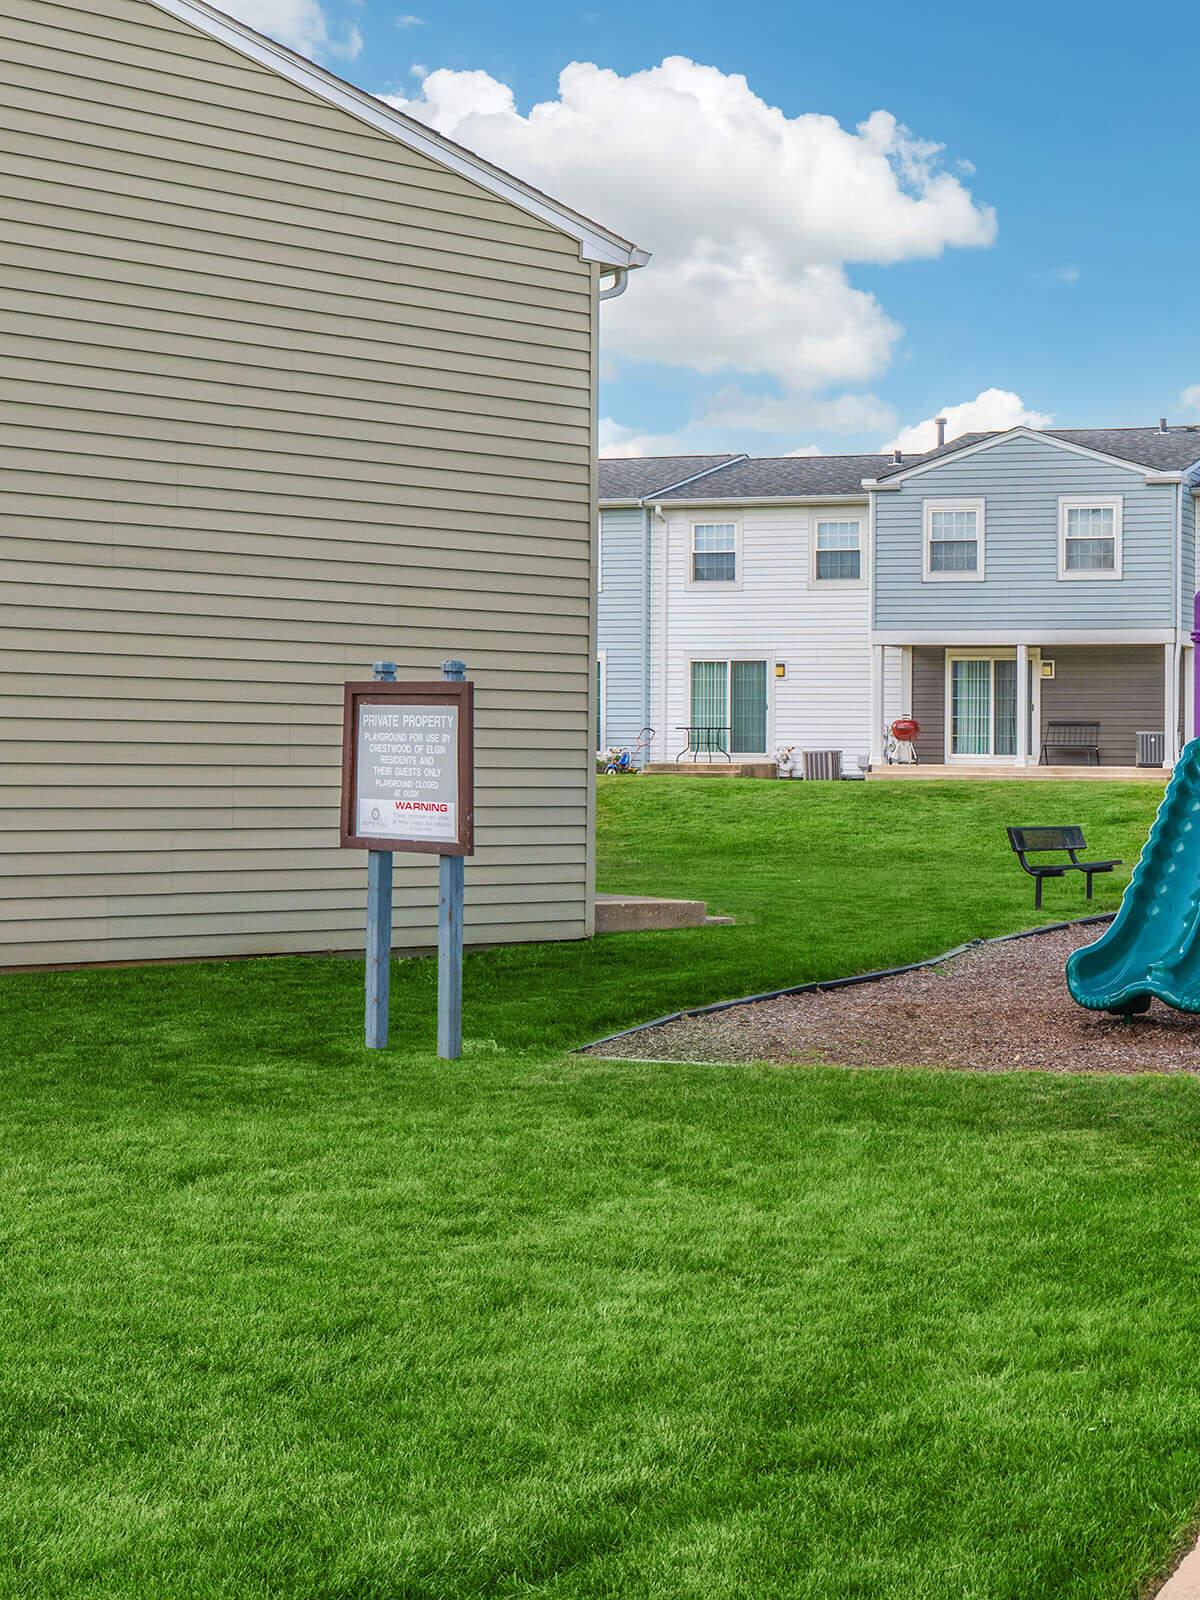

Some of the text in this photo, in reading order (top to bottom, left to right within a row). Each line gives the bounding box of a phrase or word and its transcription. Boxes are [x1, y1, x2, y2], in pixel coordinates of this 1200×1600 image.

[362, 714, 454, 728] PRIVATE PROPERTY
[364, 732, 450, 743] PLAYGROUND FOR USE BY
[369, 744, 446, 754] CRESTWOOD OF ELGIN
[380, 756, 434, 766] RESIDENTS AND
[374, 766, 442, 777] THEIR GUESTS ONLY
[416, 780, 439, 789] CLOSED
[403, 790, 419, 798] DUSK
[395, 802, 448, 812] WARNING
